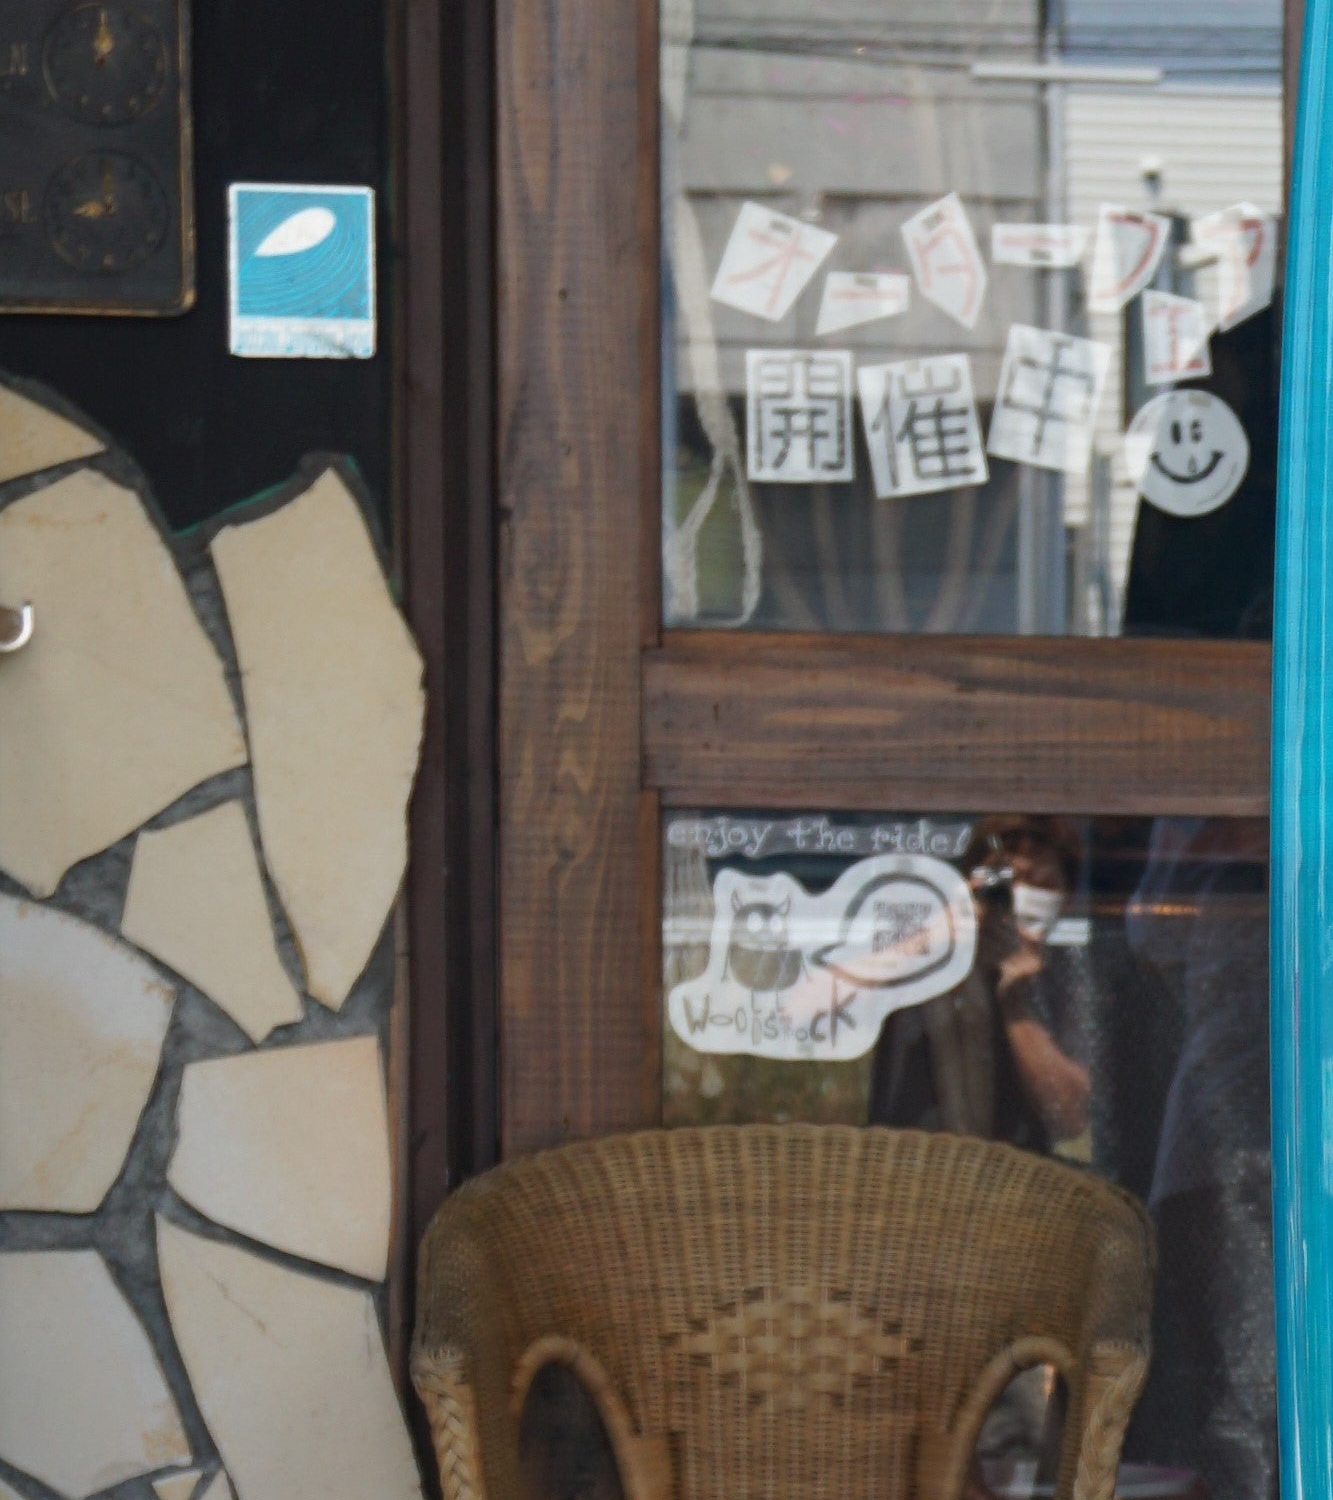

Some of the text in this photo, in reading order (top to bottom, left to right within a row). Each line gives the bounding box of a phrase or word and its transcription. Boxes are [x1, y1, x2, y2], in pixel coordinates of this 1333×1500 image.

[754, 339, 1097, 489] 開催中
[667, 815, 771, 859] enjoy
[786, 816, 855, 852] the
